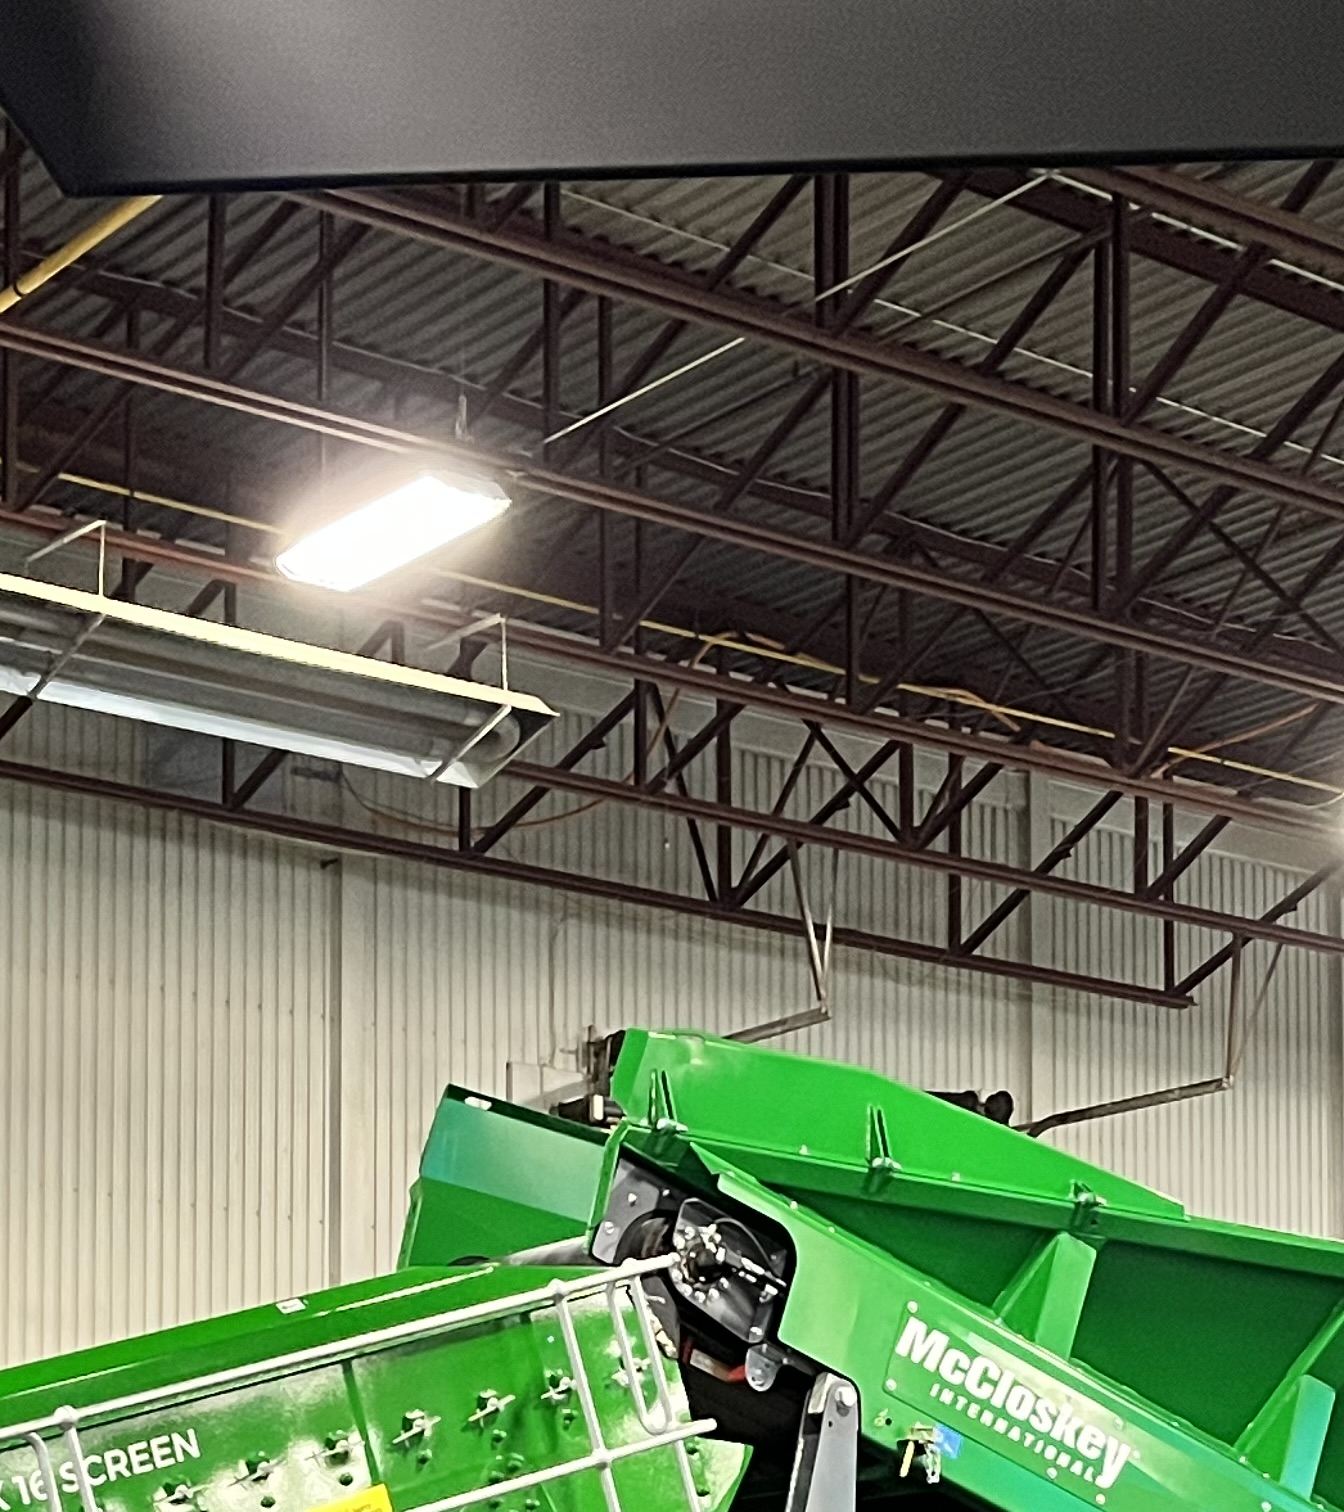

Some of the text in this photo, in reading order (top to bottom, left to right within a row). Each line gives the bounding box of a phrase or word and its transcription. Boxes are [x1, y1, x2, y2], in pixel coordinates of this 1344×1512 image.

[895, 1316, 1131, 1489] McCloskey
[930, 1383, 1097, 1483] INTERNATIONAL
[58, 1428, 201, 1494] SCREEN
